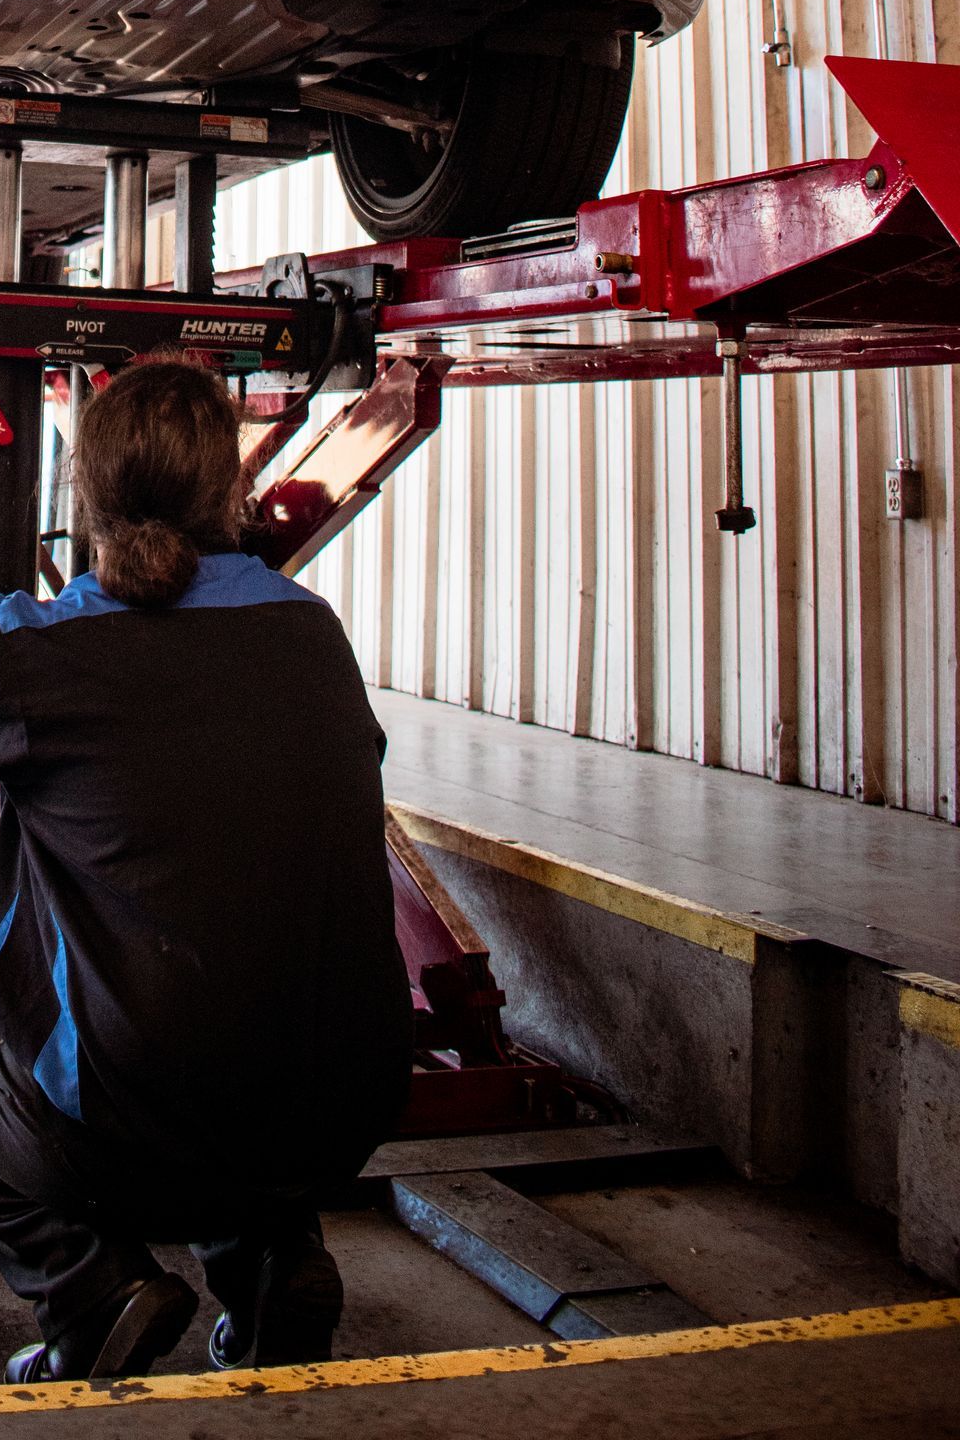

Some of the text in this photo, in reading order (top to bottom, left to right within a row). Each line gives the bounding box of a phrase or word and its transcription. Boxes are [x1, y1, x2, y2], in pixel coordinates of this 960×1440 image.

[66, 320, 106, 334] PIVOT
[181, 320, 267, 336] HUNTER
[179, 332, 265, 344] Engineering Company
[55, 348, 84, 356] RELEASE
